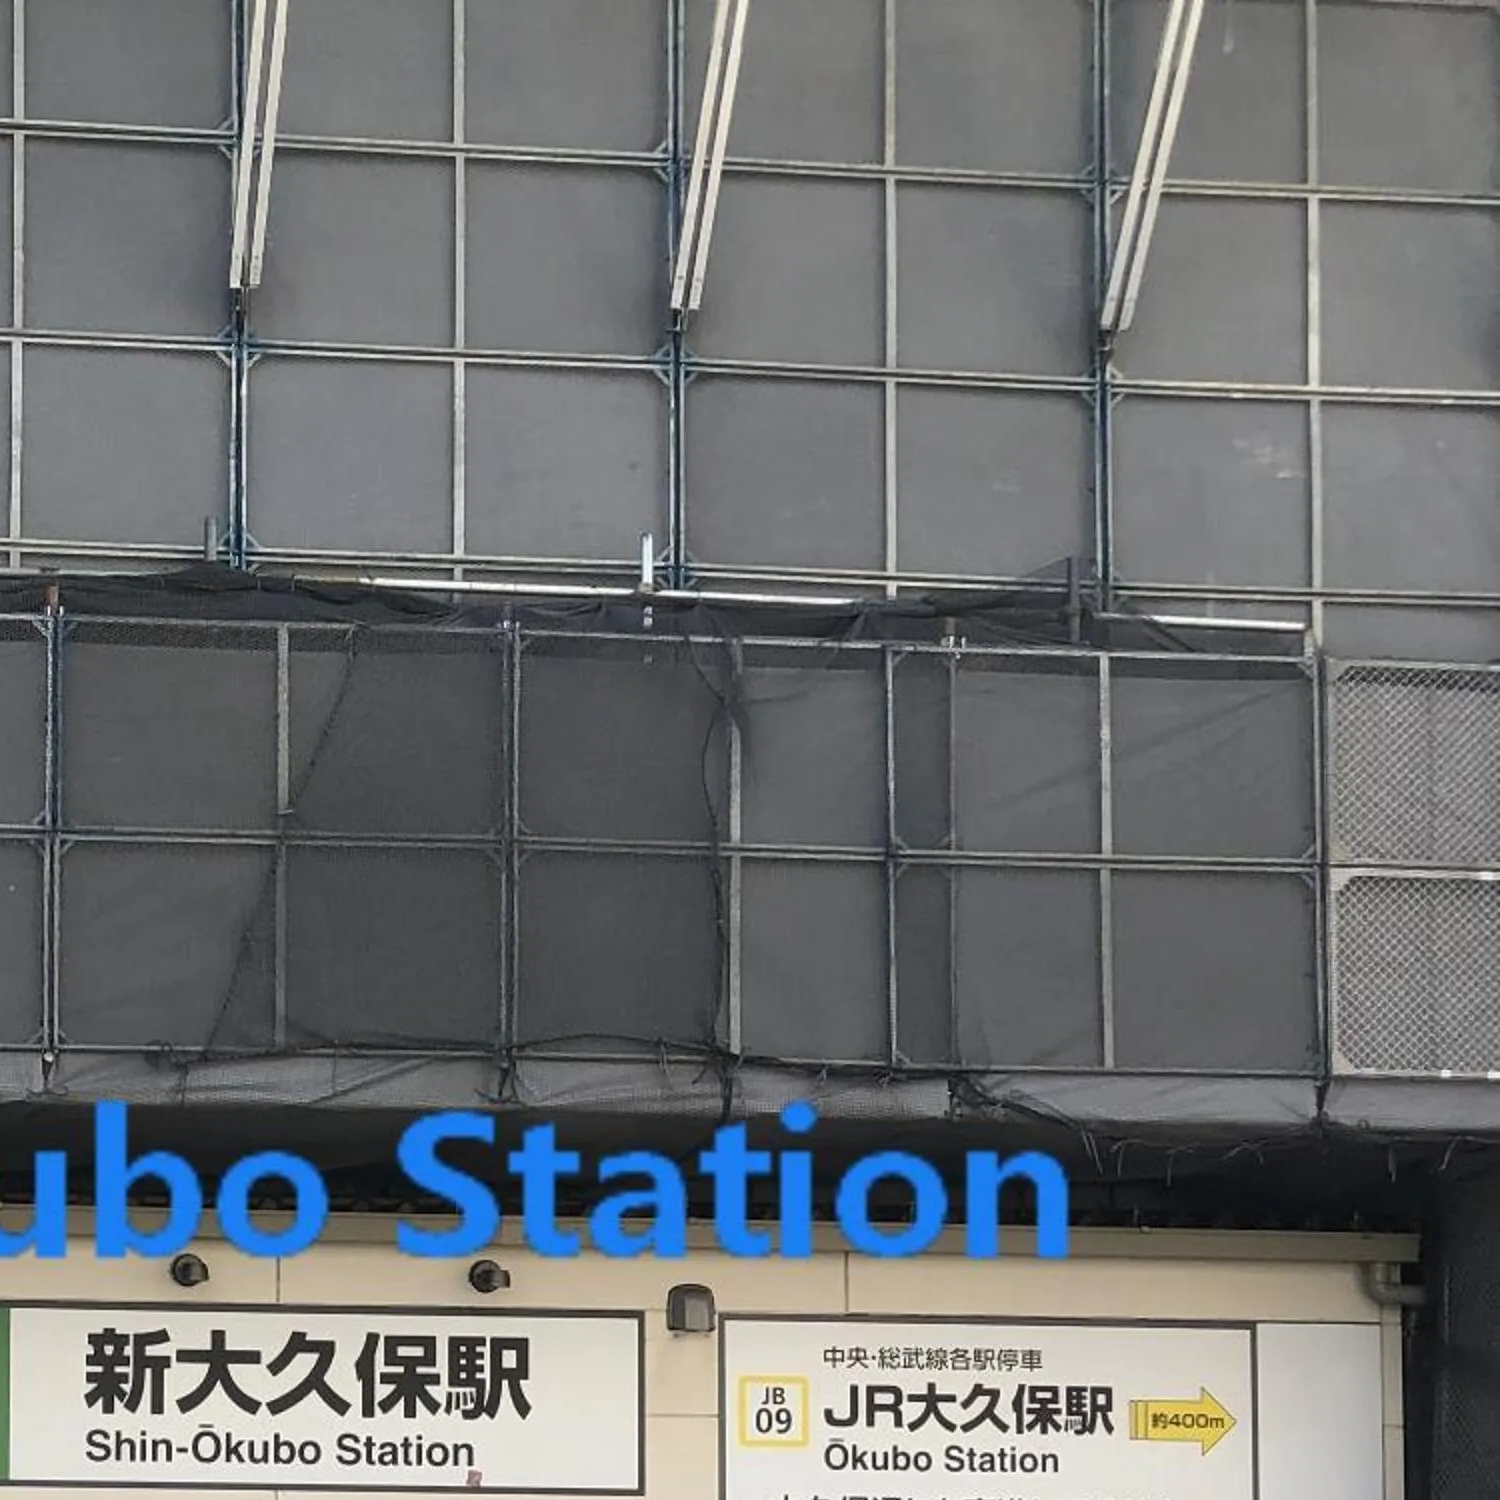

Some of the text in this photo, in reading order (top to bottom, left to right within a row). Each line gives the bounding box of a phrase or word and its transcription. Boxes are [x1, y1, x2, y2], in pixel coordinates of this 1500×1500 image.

[83, 1327, 534, 1421] 新大久保駅
[761, 1386, 786, 1406] JB
[823, 1382, 1115, 1436] JR大久保駅
[755, 1407, 793, 1435] 09
[1150, 1412, 1226, 1432] 約400m
[85, 1422, 475, 1467] Shin-Ōkubo Station
[823, 1437, 1060, 1473] Ōkubo Station
